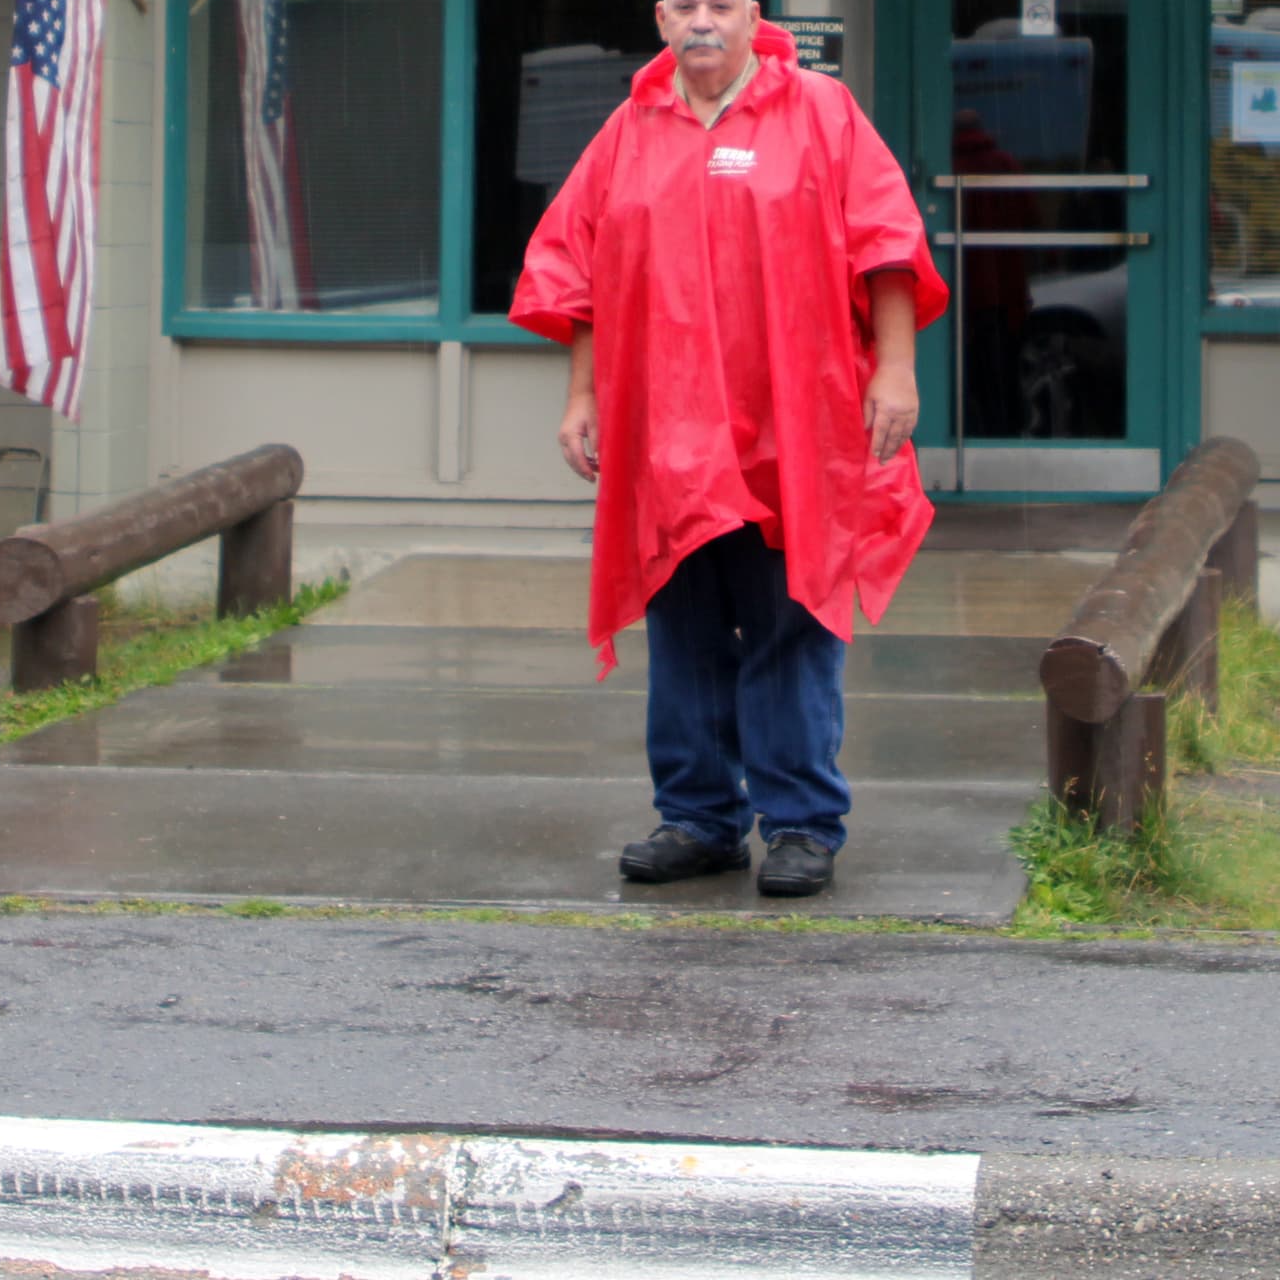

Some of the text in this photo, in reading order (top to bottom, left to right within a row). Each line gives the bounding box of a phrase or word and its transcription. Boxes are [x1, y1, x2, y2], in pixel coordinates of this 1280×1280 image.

[776, 21, 843, 33] GISTRATION
[795, 34, 825, 46] FFICE
[797, 48, 821, 60] PEN
